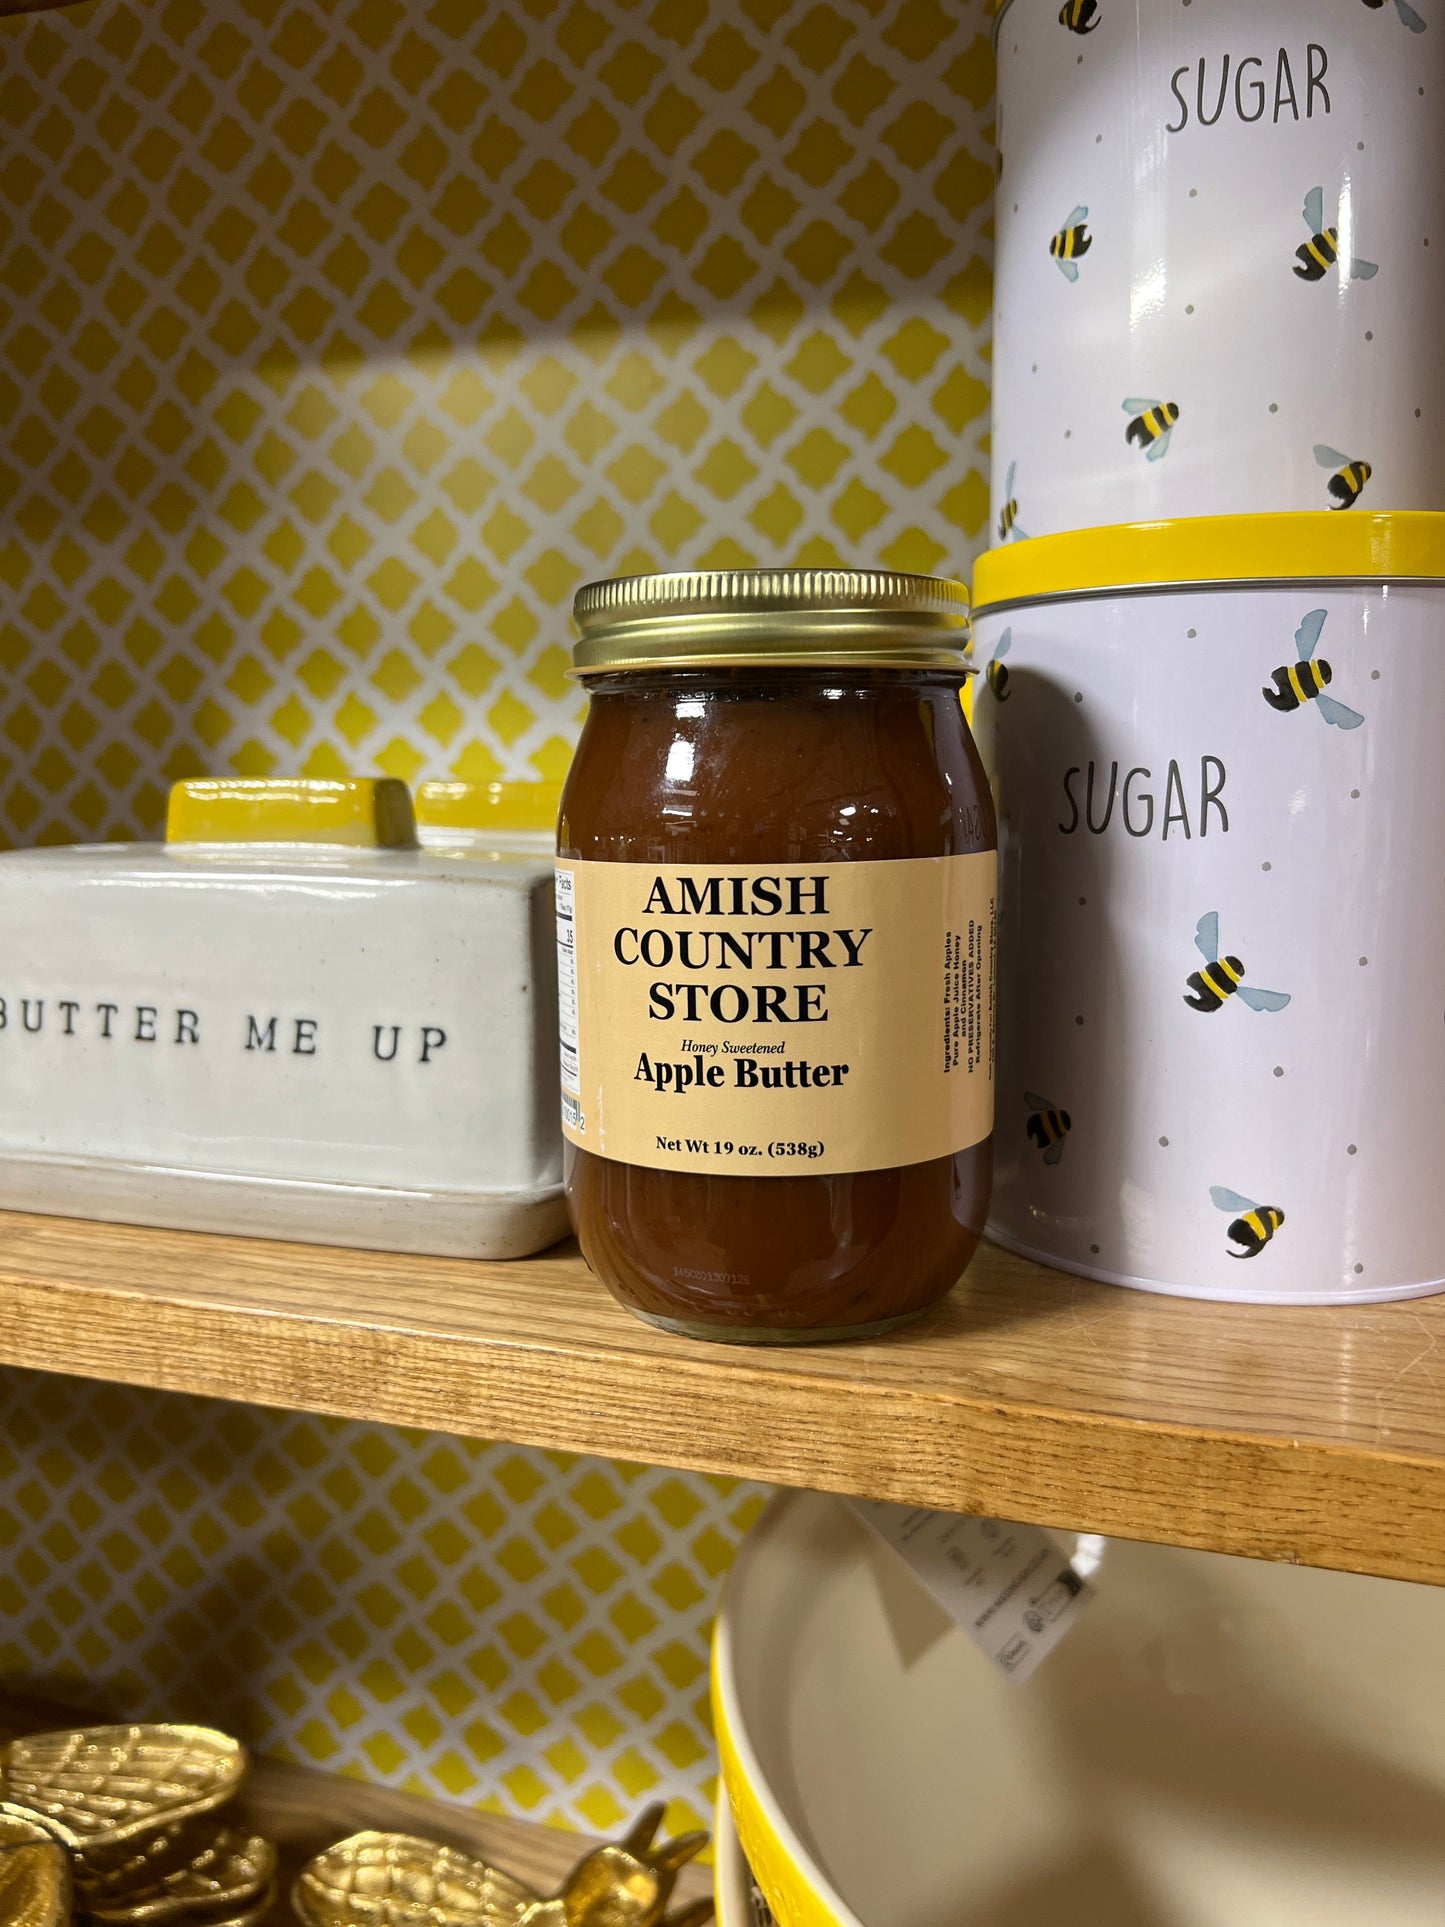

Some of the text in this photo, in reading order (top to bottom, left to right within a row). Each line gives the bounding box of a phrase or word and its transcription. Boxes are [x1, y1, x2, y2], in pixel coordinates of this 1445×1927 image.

[1166, 43, 1331, 133] SUGAR
[1058, 755, 1229, 841] SUGAR
[642, 876, 830, 917] AMISH
[613, 927, 873, 970] COUNTRY
[953, 934, 962, 970] Honey
[648, 982, 829, 1023] STORE
[943, 931, 952, 1074] Ingredients: Fresh Apples
[244, 1015, 319, 1055] ME
[372, 1025, 447, 1063] UP
[681, 1038, 785, 1057] Honey Sweetened
[634, 1052, 849, 1093] Apple Butter
[968, 1055, 974, 1074] NO
[580, 1116, 586, 1131] 2
[655, 1136, 825, 1158] Net Wt 19 oz. (538g)
